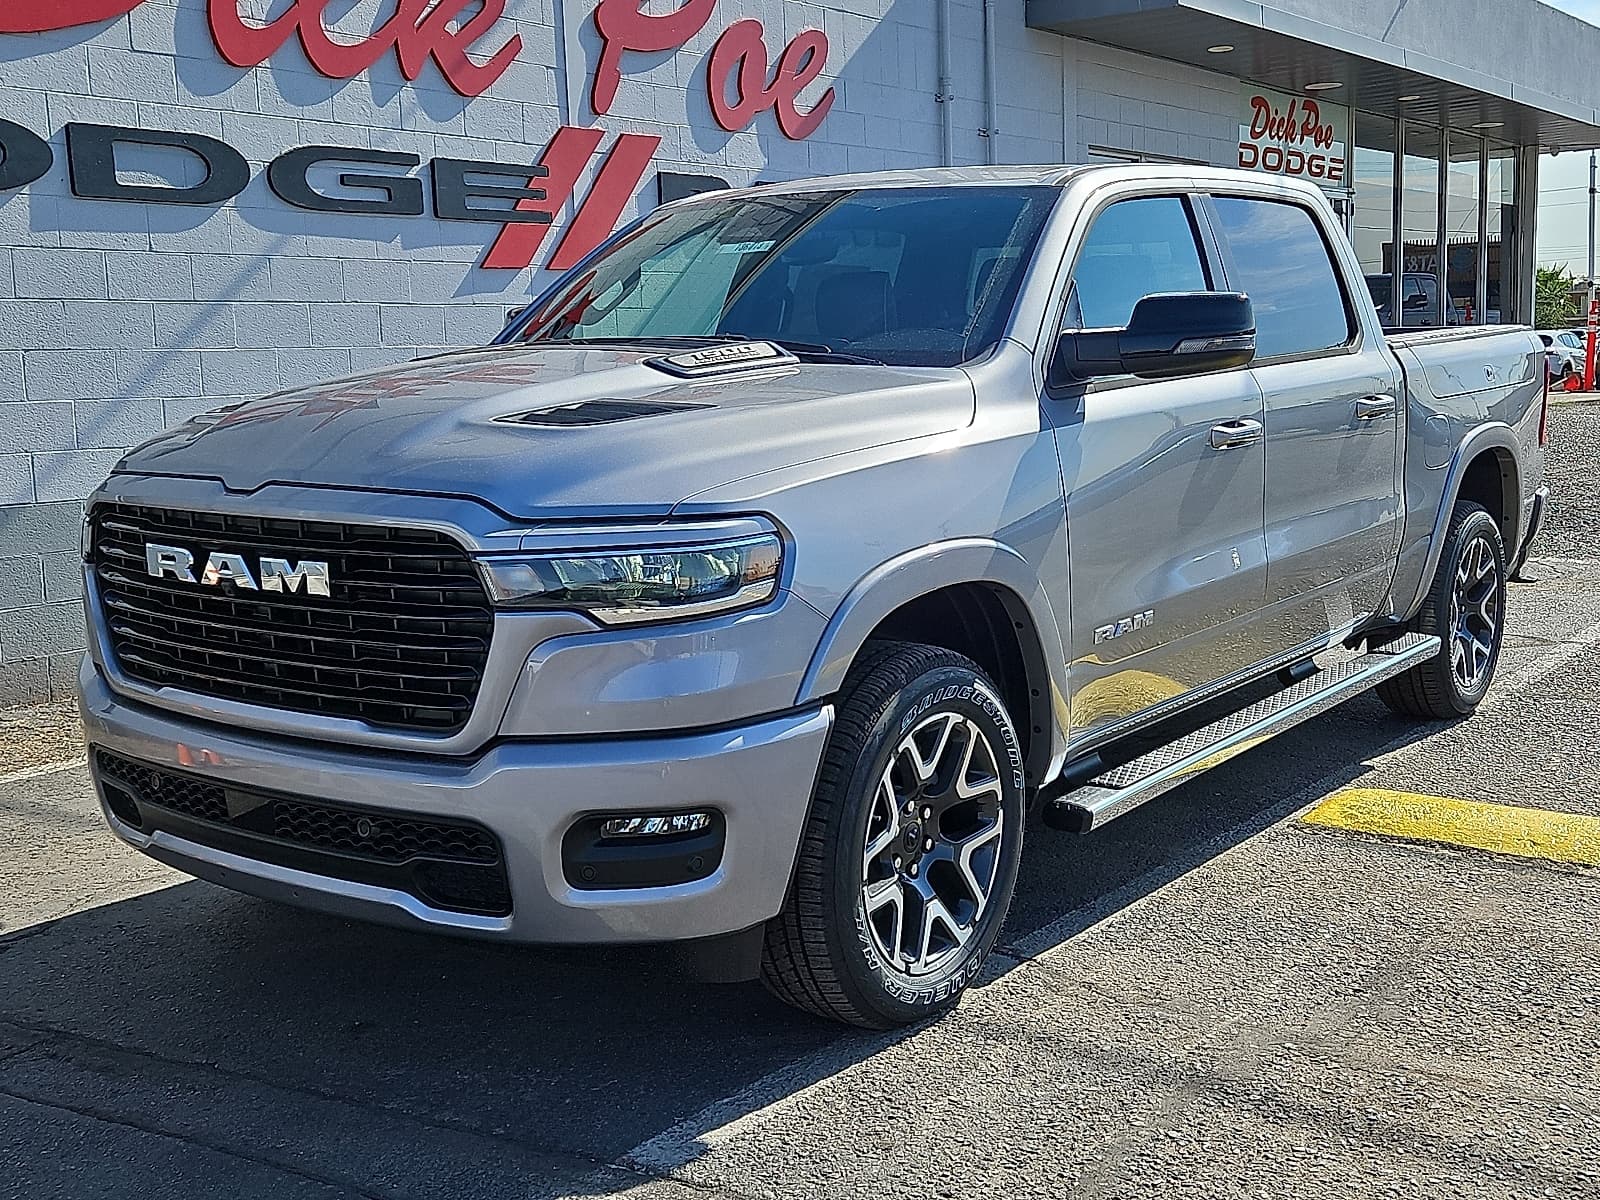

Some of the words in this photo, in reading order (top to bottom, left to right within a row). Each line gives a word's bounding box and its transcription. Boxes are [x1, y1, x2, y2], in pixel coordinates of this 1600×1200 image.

[592, 0, 835, 141] Poe
[1250, 95, 1298, 144] Dick
[1301, 99, 1334, 150] Poe
[1238, 142, 1345, 181] DODGE
[146, 542, 331, 598] RAM
[1093, 609, 1155, 645] RAM
[899, 685, 1025, 790] BRIDGESTONE
[884, 948, 982, 1005] DUELER
